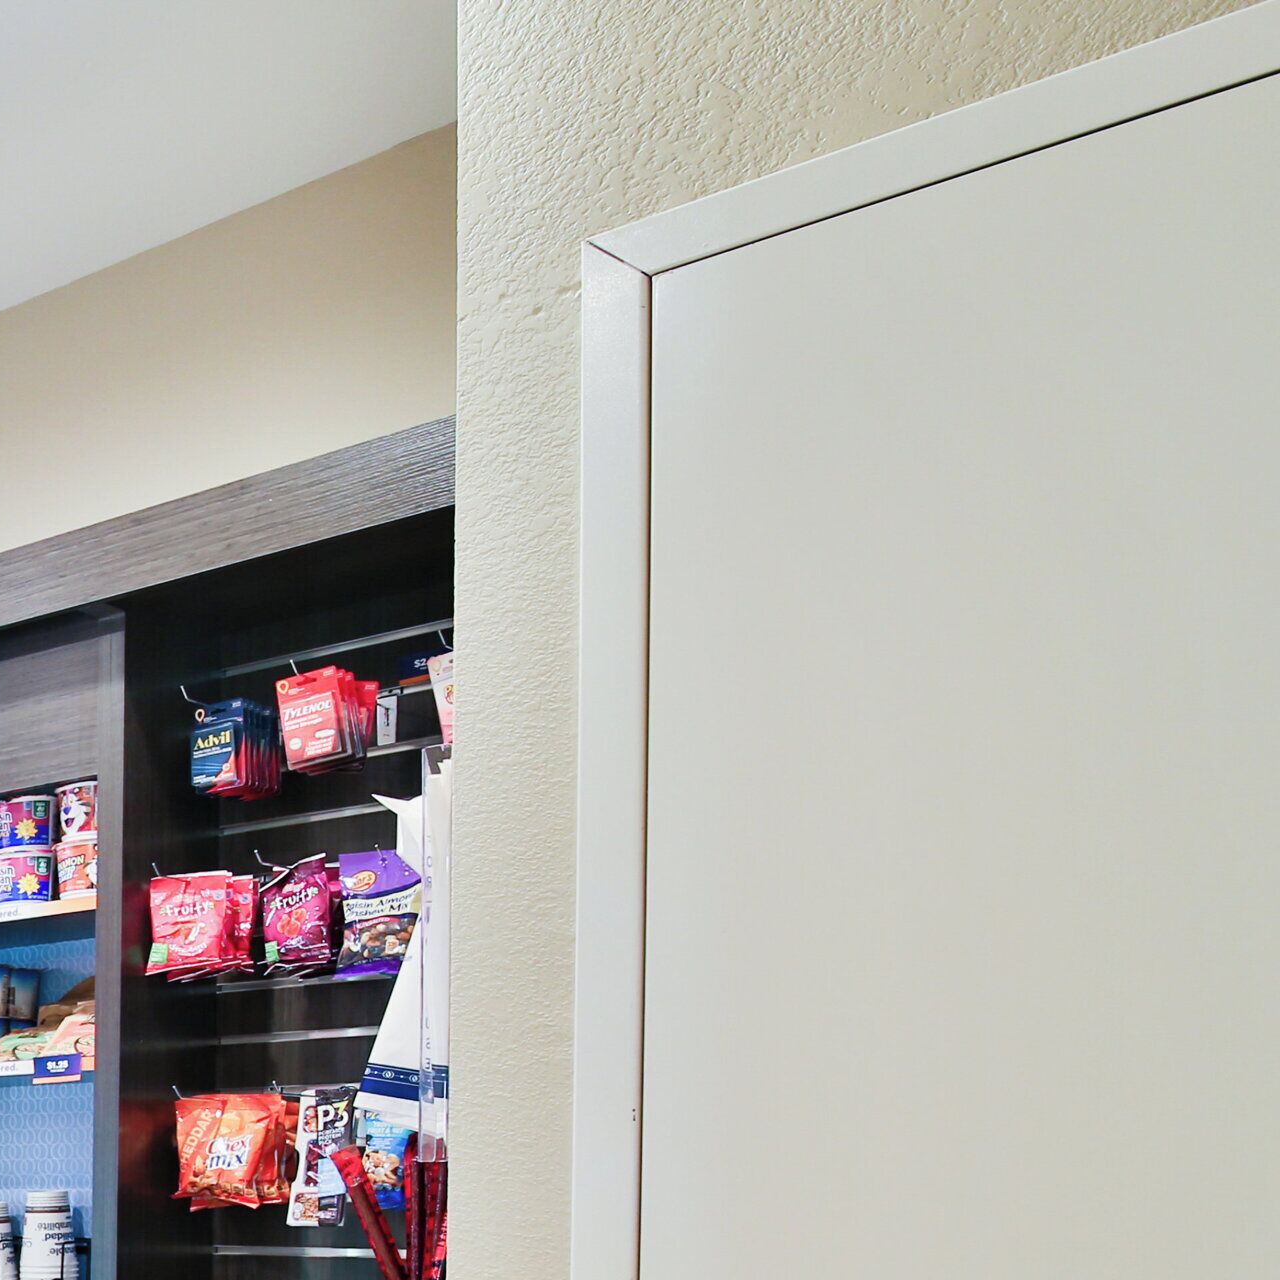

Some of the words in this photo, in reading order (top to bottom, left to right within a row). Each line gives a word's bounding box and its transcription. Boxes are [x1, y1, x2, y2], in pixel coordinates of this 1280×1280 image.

[282, 700, 333, 720] TYLENOL
[194, 730, 232, 750] Advil
[166, 902, 210, 916] Fruity
[276, 888, 314, 910] Fruity
[388, 904, 408, 913] Mix
[317, 1104, 348, 1132] P3
[180, 1109, 214, 1174] CHEDDAR
[209, 1154, 243, 1169] mix
